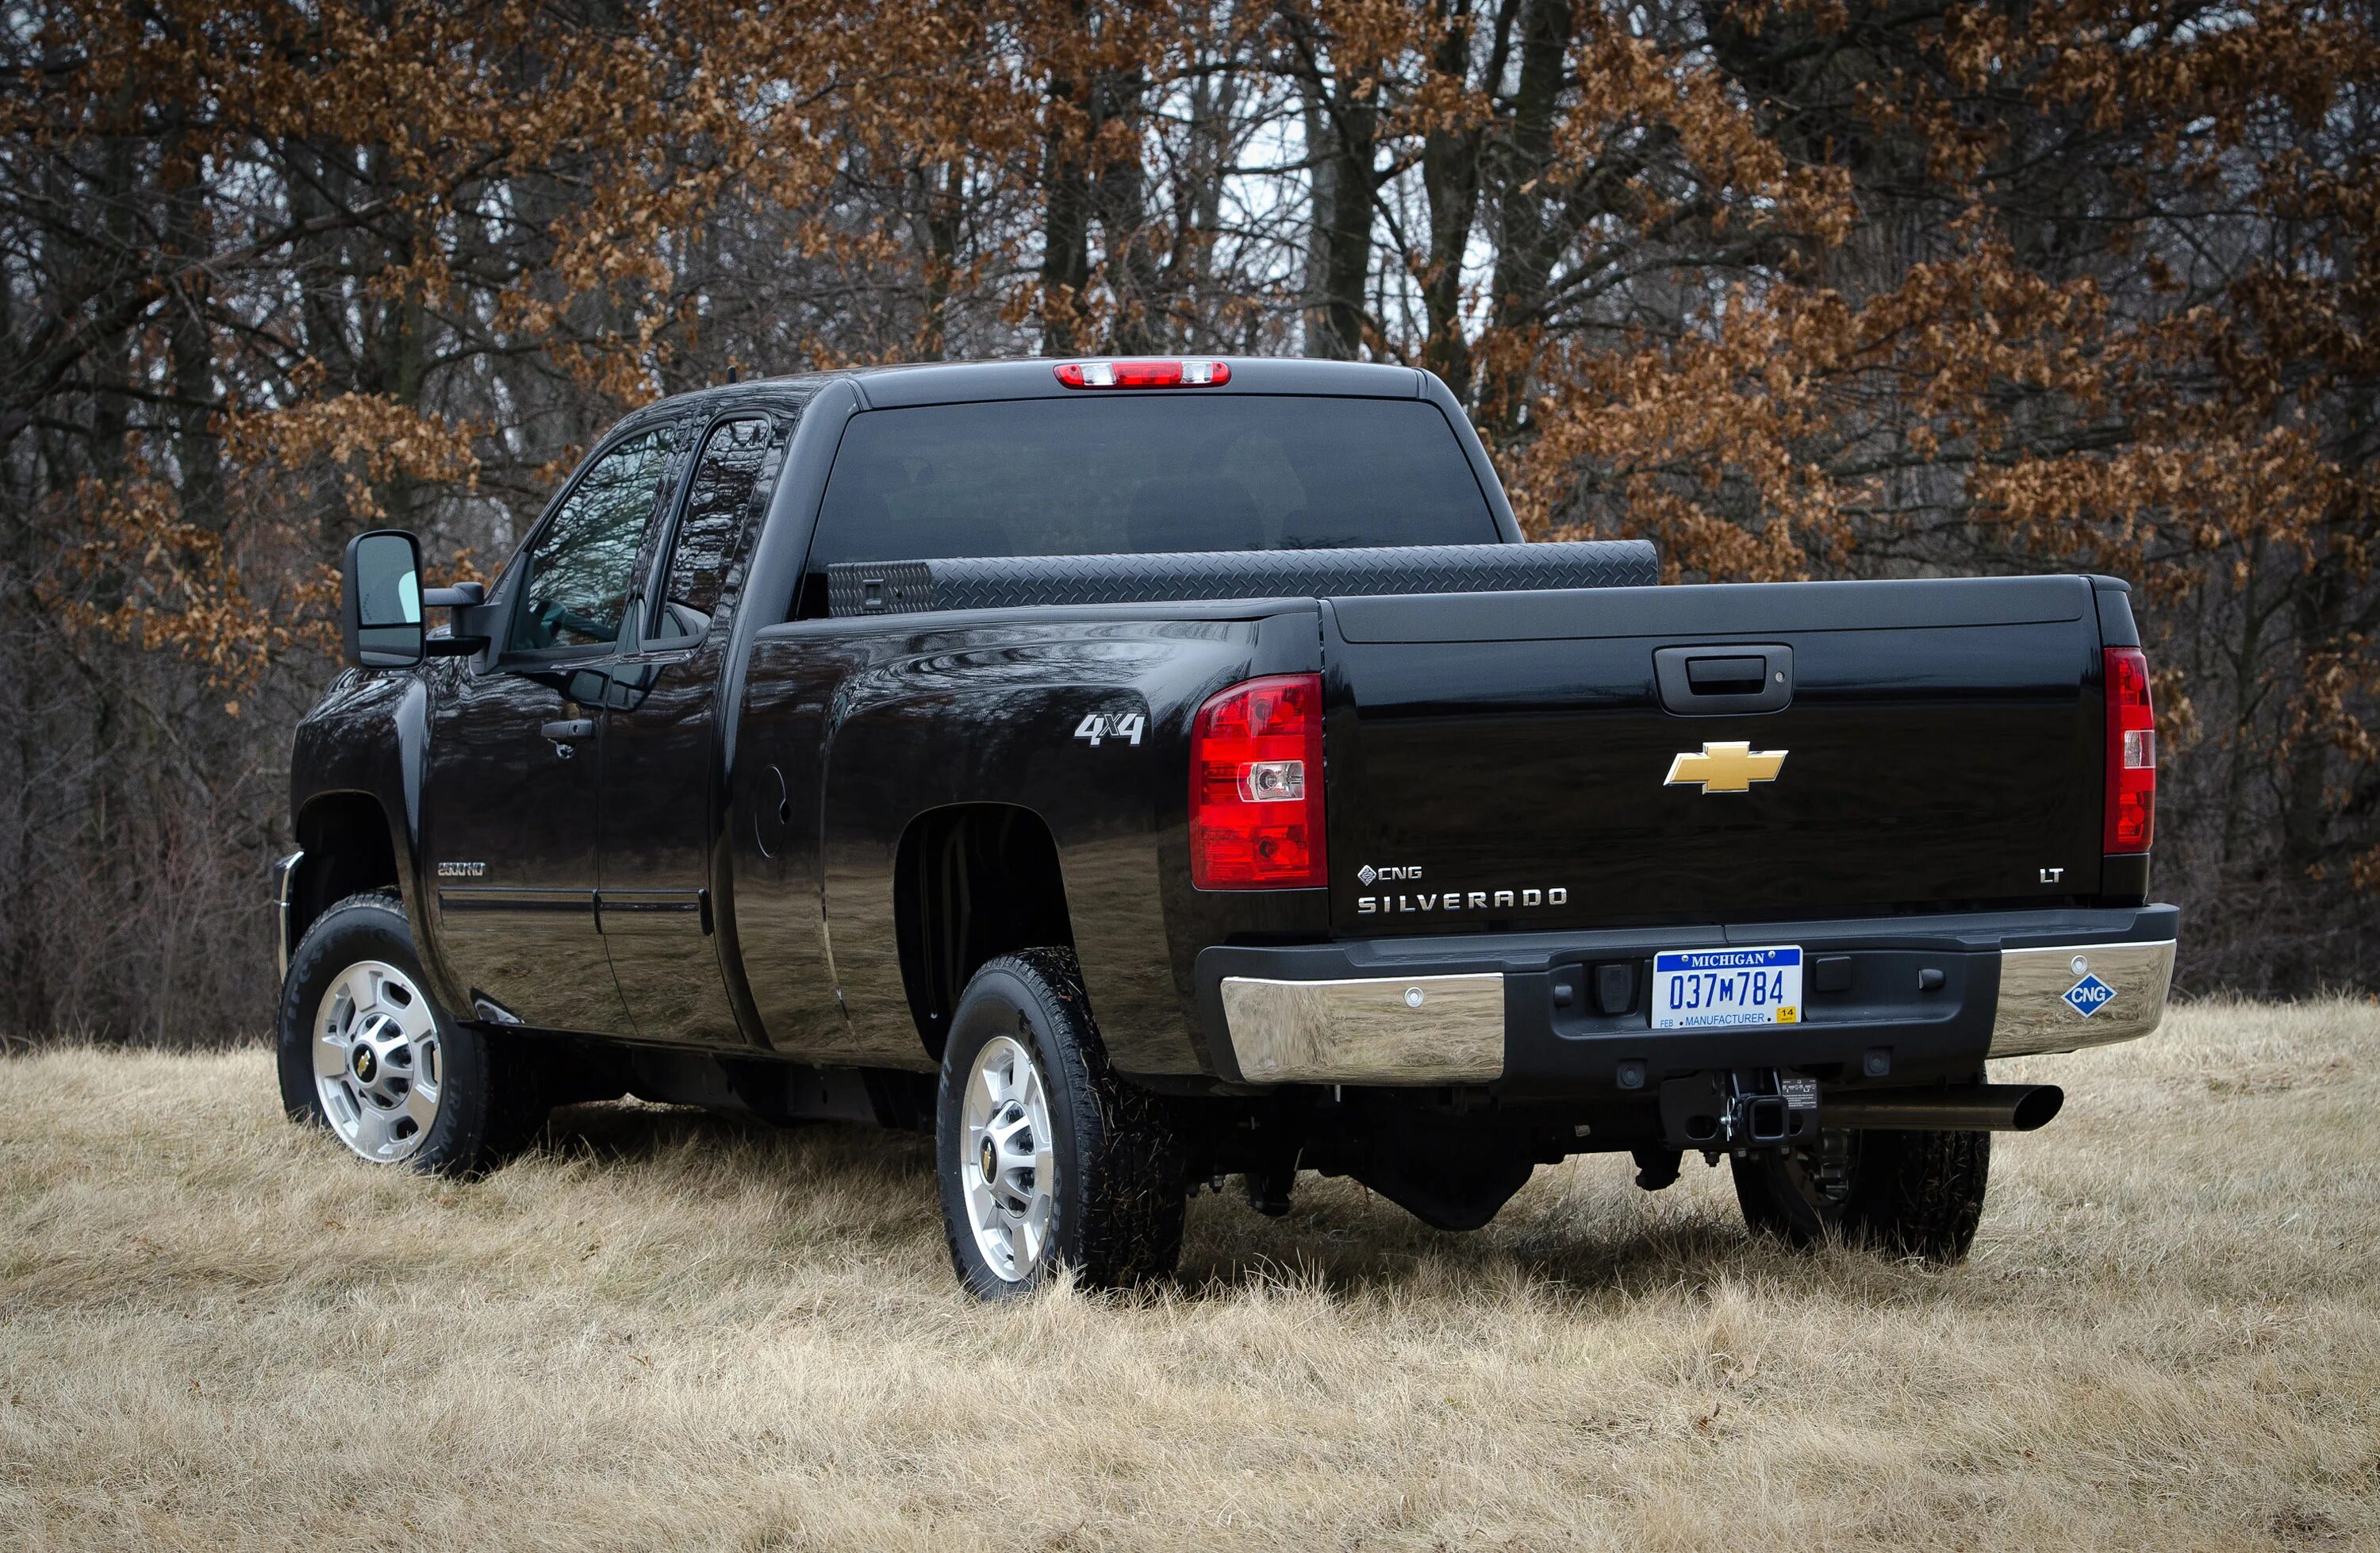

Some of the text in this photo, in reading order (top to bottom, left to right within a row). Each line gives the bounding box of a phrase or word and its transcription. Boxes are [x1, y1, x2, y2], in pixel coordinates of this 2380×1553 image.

[1377, 866, 1422, 881] CNG
[2040, 868, 2063, 883] LT
[1357, 887, 1568, 914] SILVERADO
[1691, 953, 1765, 967] MICHIGAN
[1669, 970, 1783, 1010] 037M784
[2071, 986, 2106, 1004] CNG
[1660, 1019, 1674, 1028] FEB
[1685, 1013, 1765, 1027] MANUFACTURER
